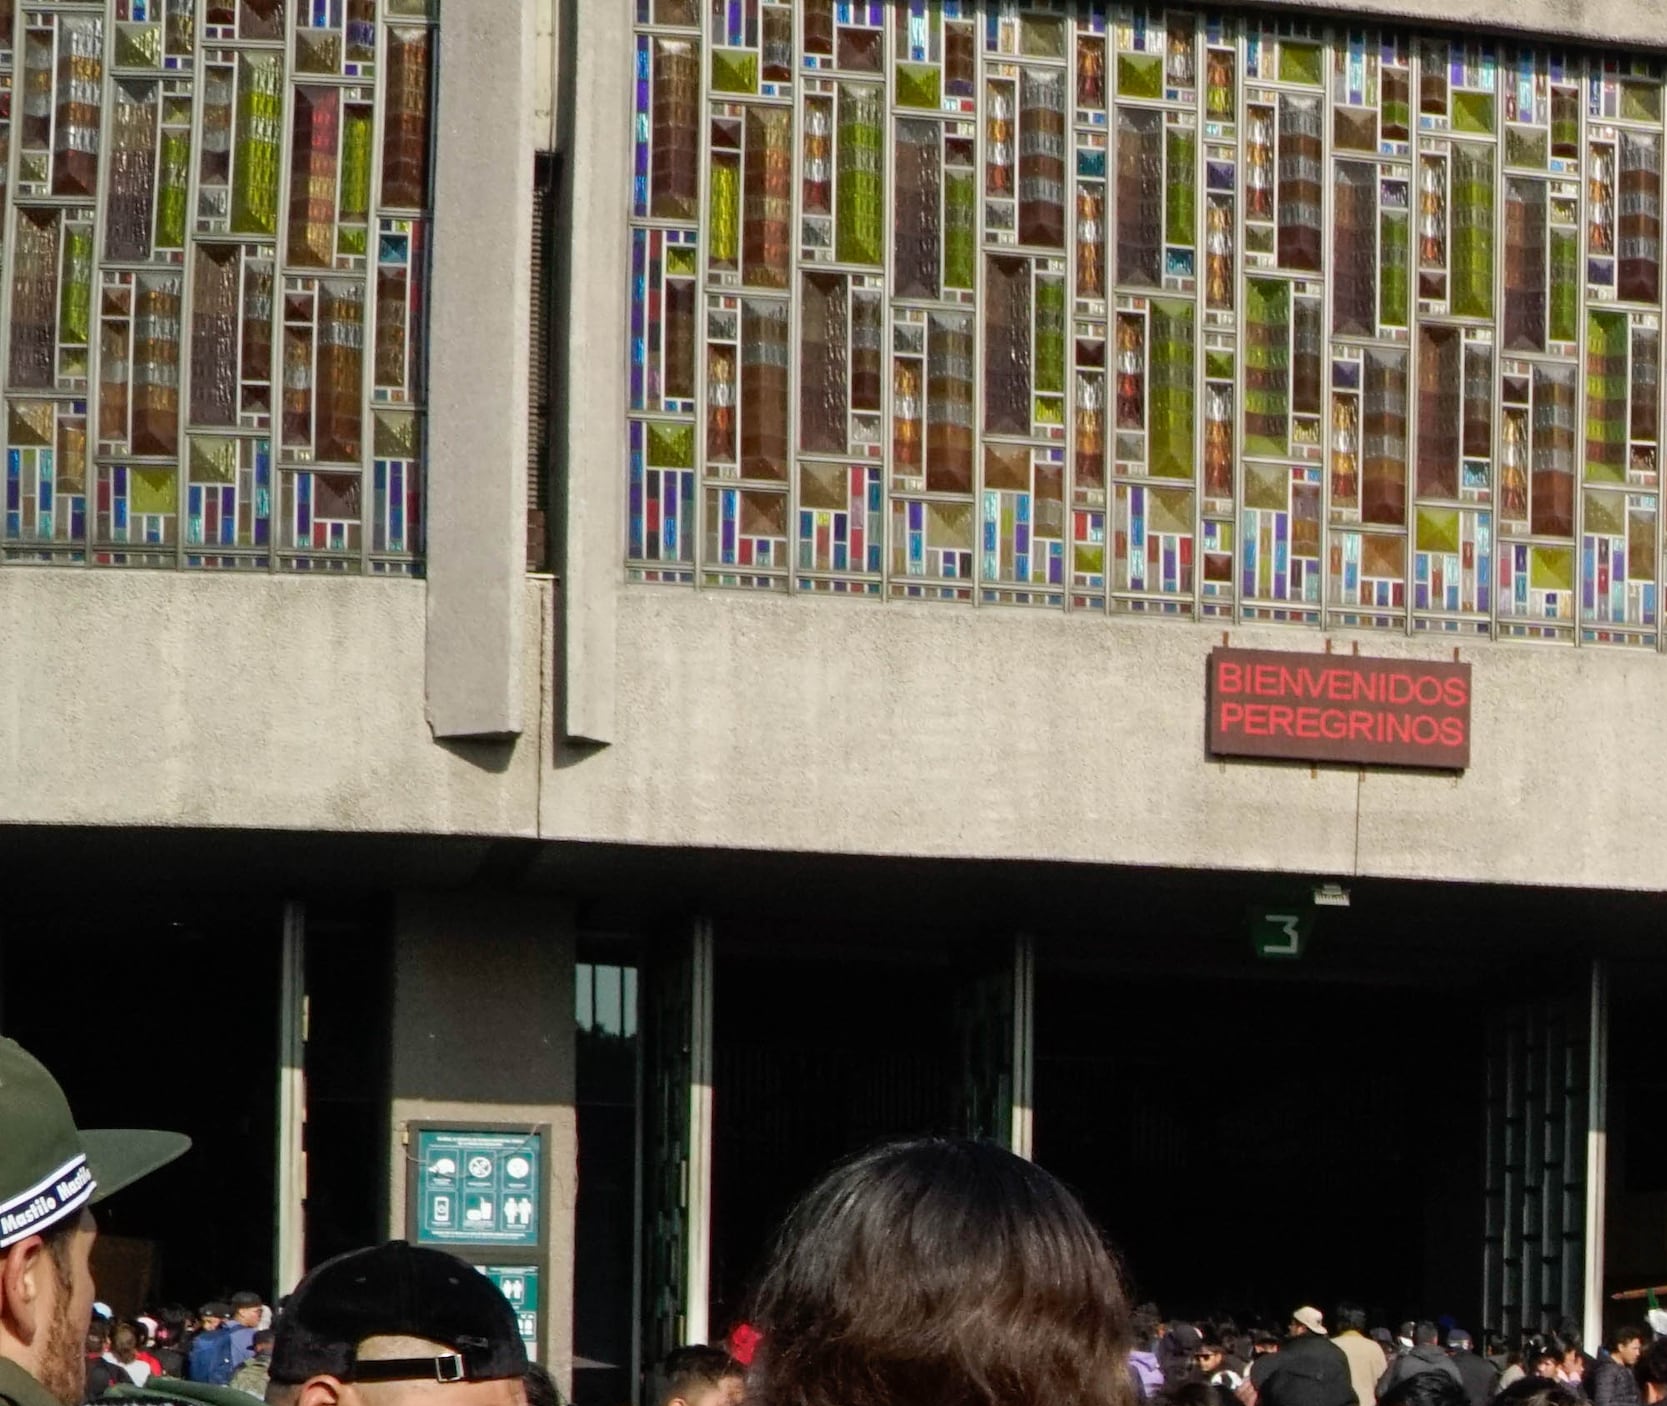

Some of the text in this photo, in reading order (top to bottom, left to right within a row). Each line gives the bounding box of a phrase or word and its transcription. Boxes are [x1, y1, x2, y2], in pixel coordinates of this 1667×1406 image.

[1218, 662, 1467, 707] BIENVENIDOS
[1219, 702, 1465, 747] PEREGRINOS
[1263, 914, 1299, 954] 3
[1, 1196, 57, 1235] Mastilo
